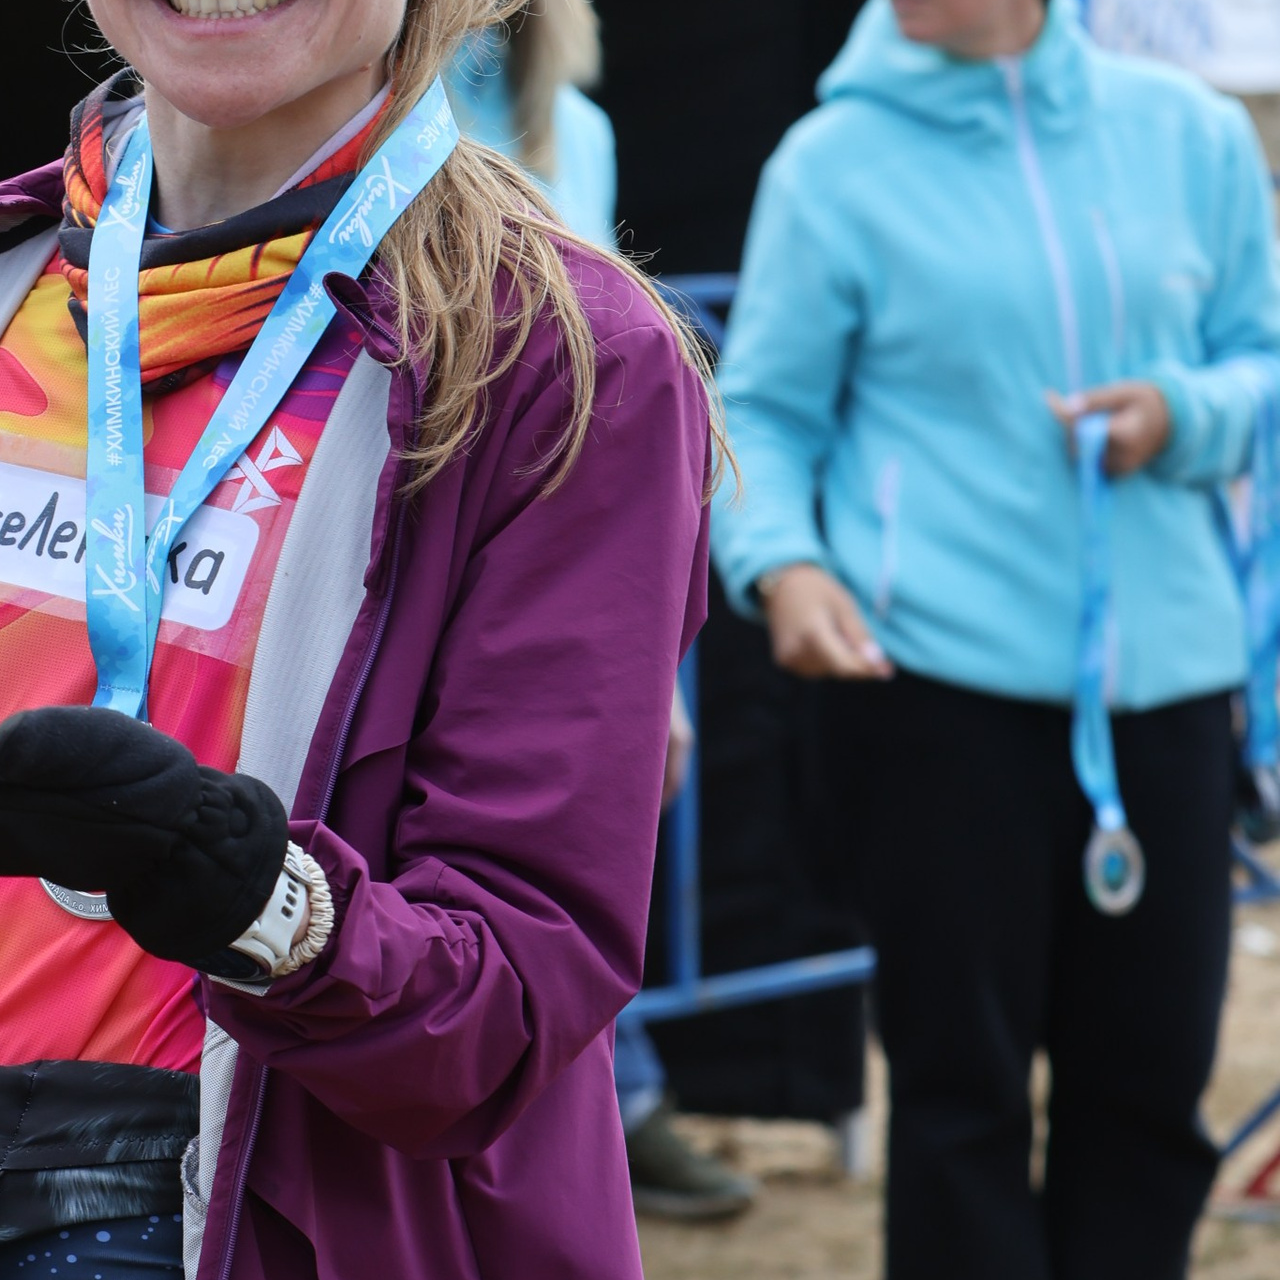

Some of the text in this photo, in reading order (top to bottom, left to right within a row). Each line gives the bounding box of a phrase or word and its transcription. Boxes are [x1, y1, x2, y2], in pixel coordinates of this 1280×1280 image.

[104, 267, 121, 308] ЛЕС
[202, 432, 233, 470] ЛЕС
[90, 904, 109, 913] ХИМ
